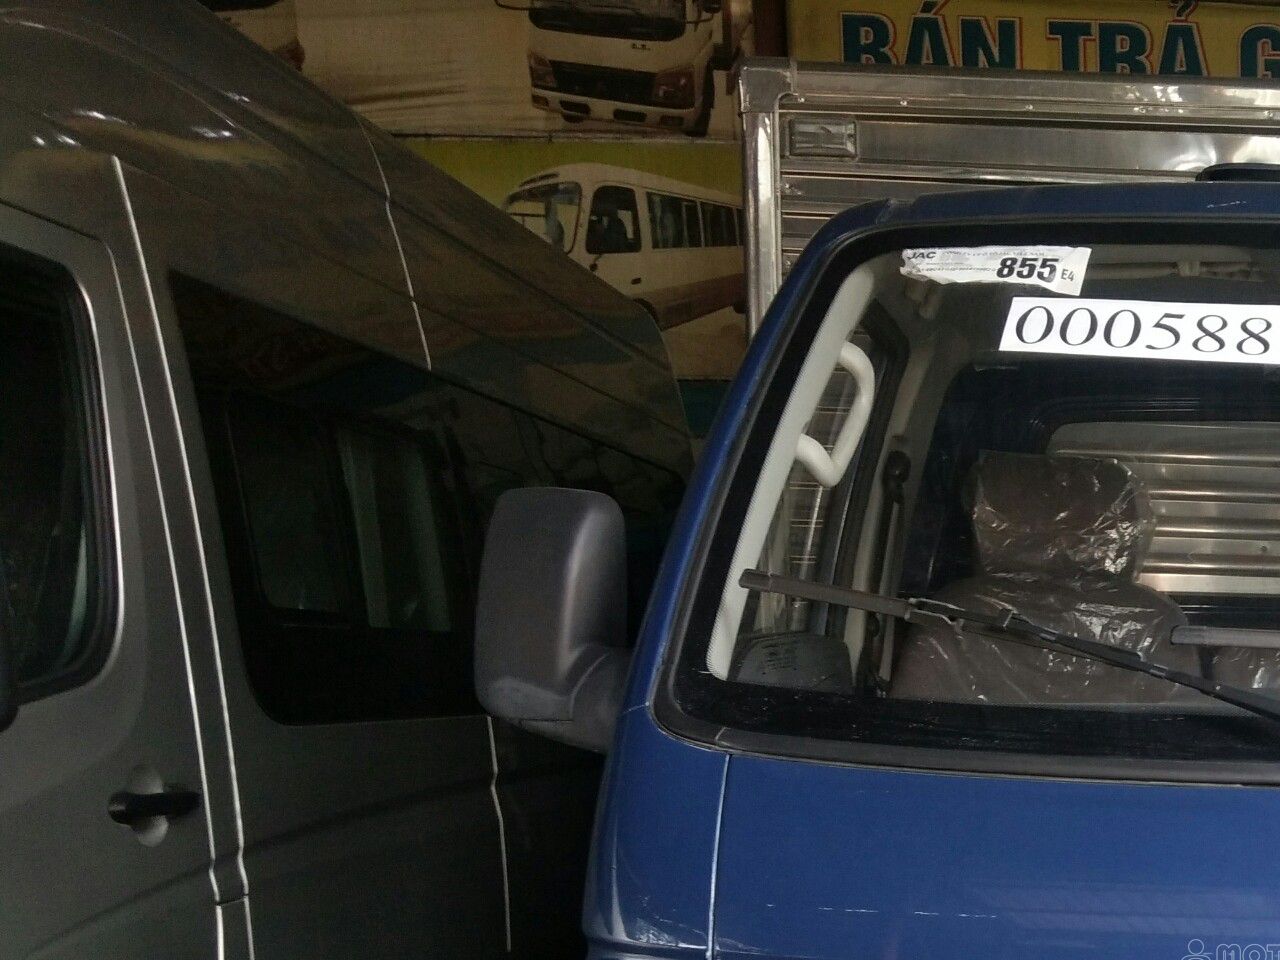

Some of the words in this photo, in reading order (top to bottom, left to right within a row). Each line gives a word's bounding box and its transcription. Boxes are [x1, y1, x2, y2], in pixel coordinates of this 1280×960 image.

[840, 0, 1019, 71] BÁN
[1046, 0, 1206, 77] TRẢ
[907, 251, 936, 260] JAC
[996, 257, 1059, 283] 855
[1060, 268, 1076, 282] E4
[1015, 306, 1273, 356] 000588
